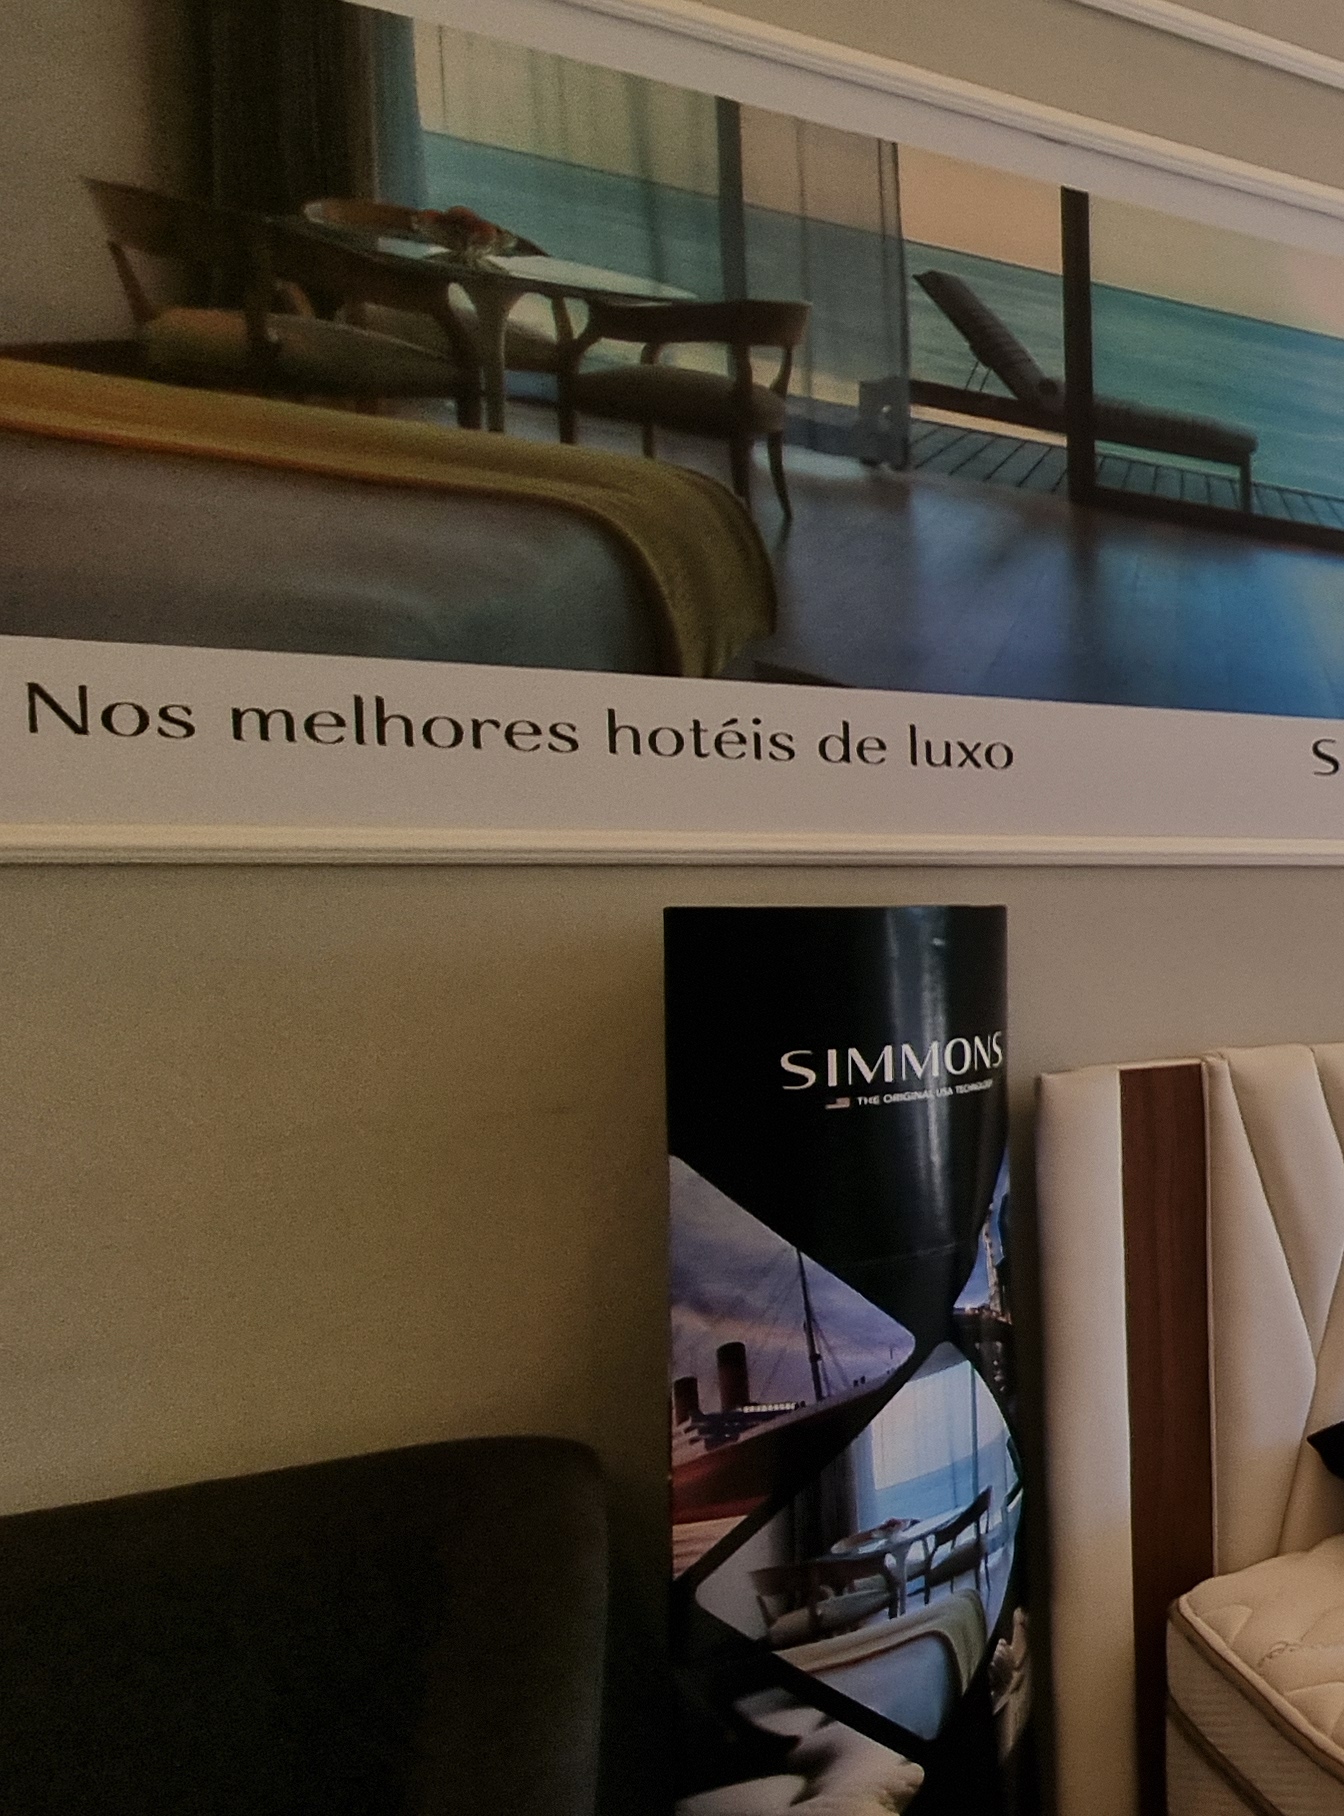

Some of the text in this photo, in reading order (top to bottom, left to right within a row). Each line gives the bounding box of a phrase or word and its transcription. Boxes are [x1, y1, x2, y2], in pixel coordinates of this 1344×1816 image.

[27, 682, 1014, 772] Nos melhores hotéis de luxo
[780, 1031, 1003, 1090] SIMMONS
[857, 1096, 880, 1105] THE
[883, 1089, 935, 1104] ORIGINAL
[936, 1086, 953, 1097] USA
